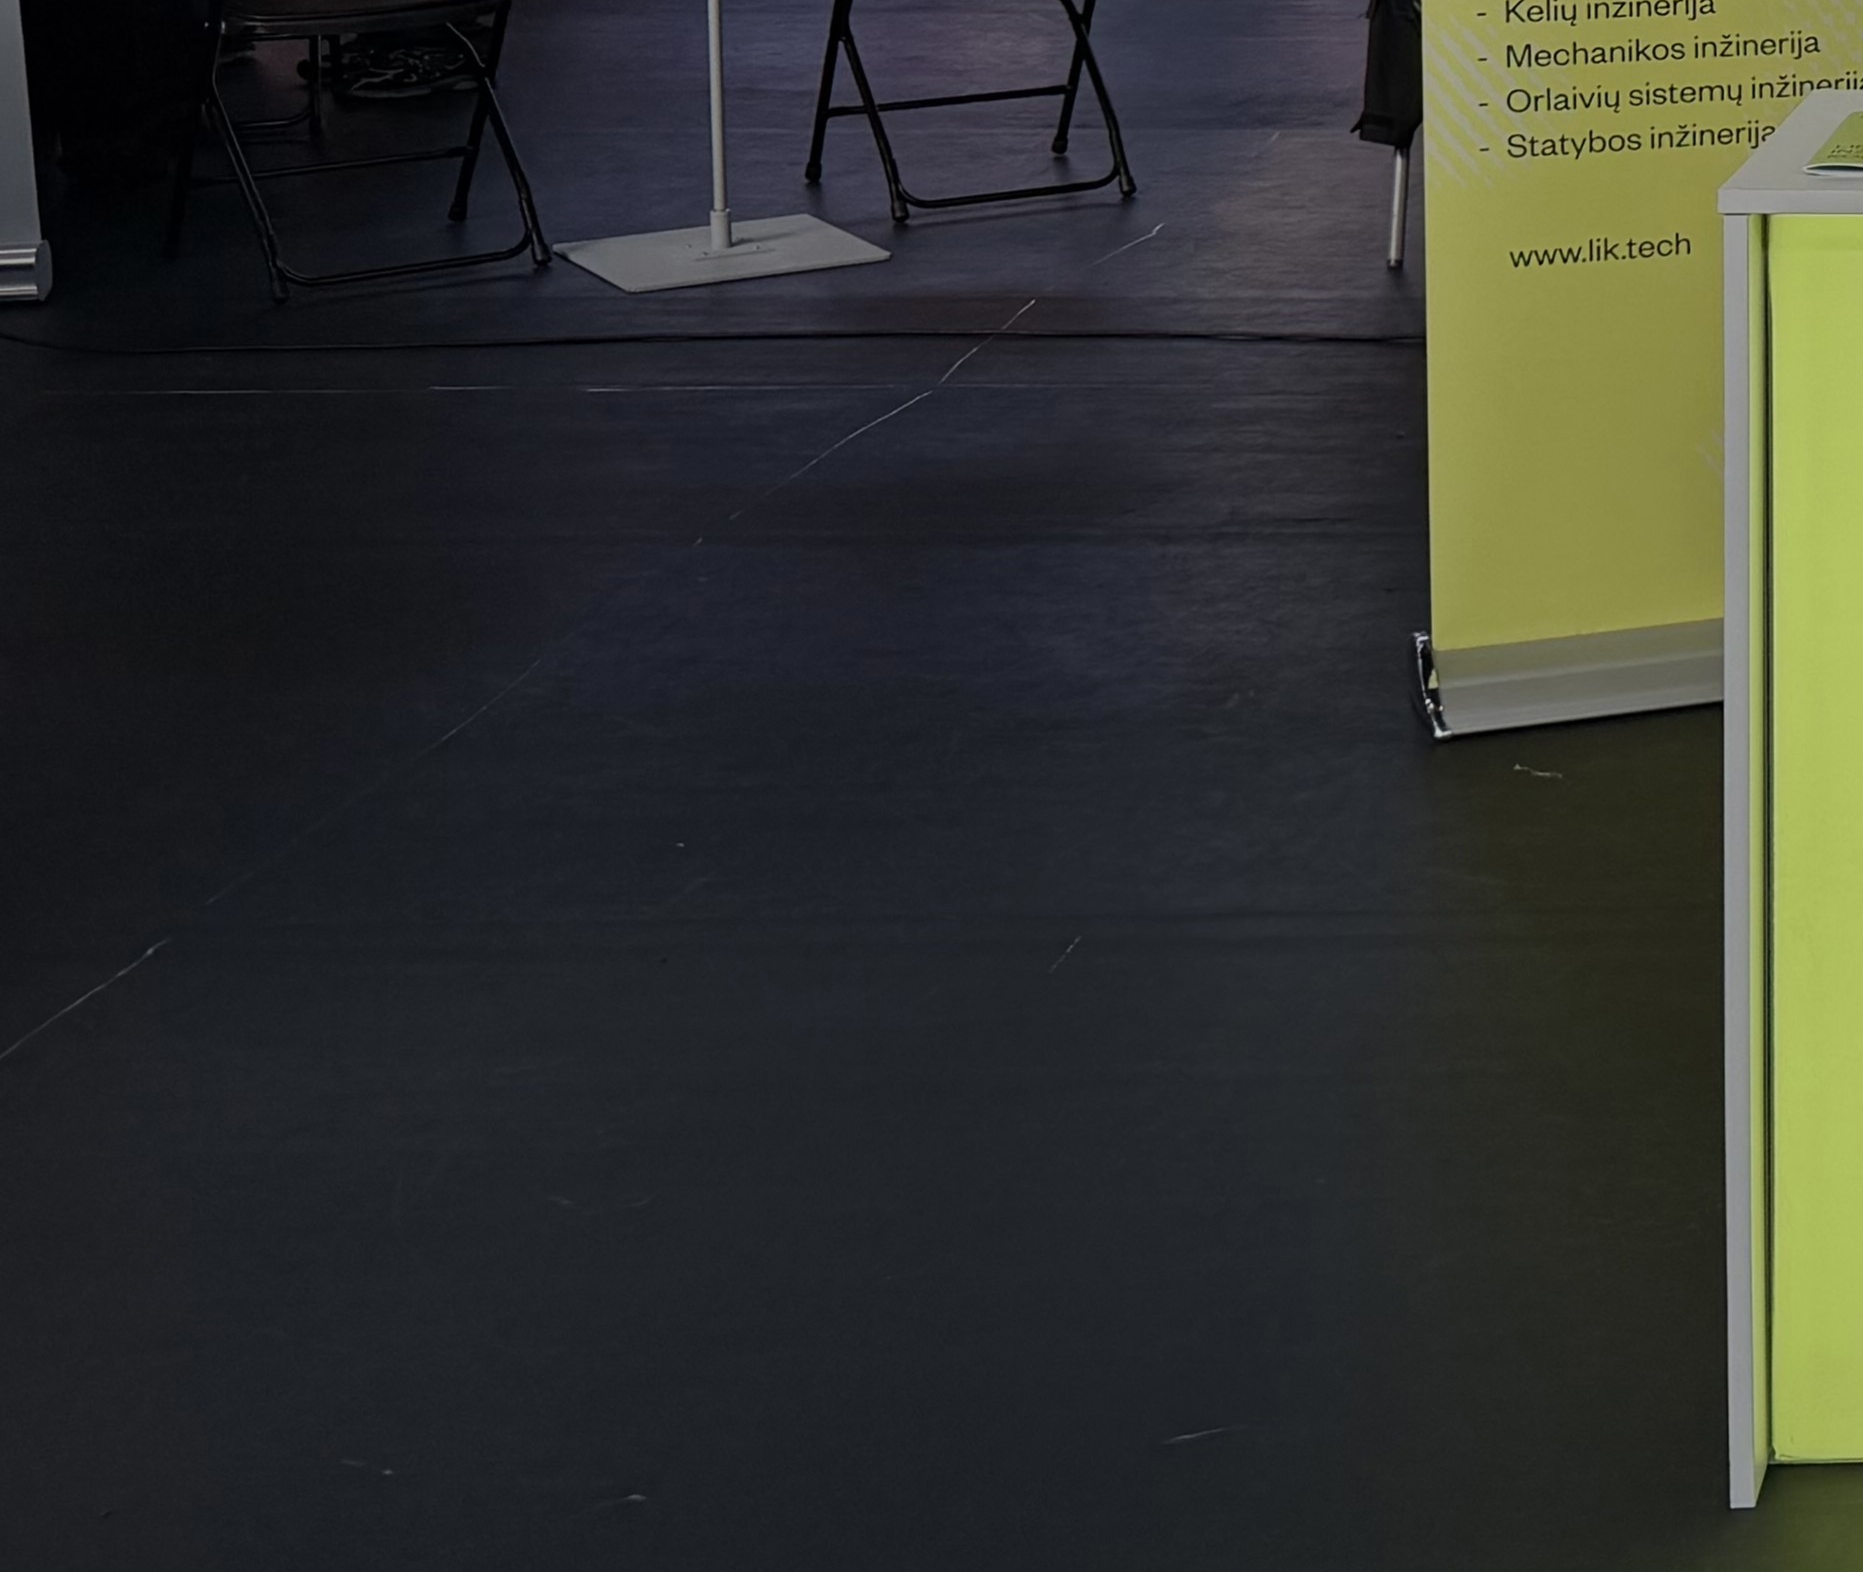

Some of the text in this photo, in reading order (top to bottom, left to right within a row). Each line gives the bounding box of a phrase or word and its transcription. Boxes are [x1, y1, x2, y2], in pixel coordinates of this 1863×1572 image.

[1505, 30, 1821, 69] Mechanikos inžinerija
[1505, 87, 1621, 115] Orlaivių
[1627, 81, 1743, 108] sistemų
[1506, 122, 1775, 161] Statybos inžinerija
[1509, 232, 1692, 268] www.lik.tech
